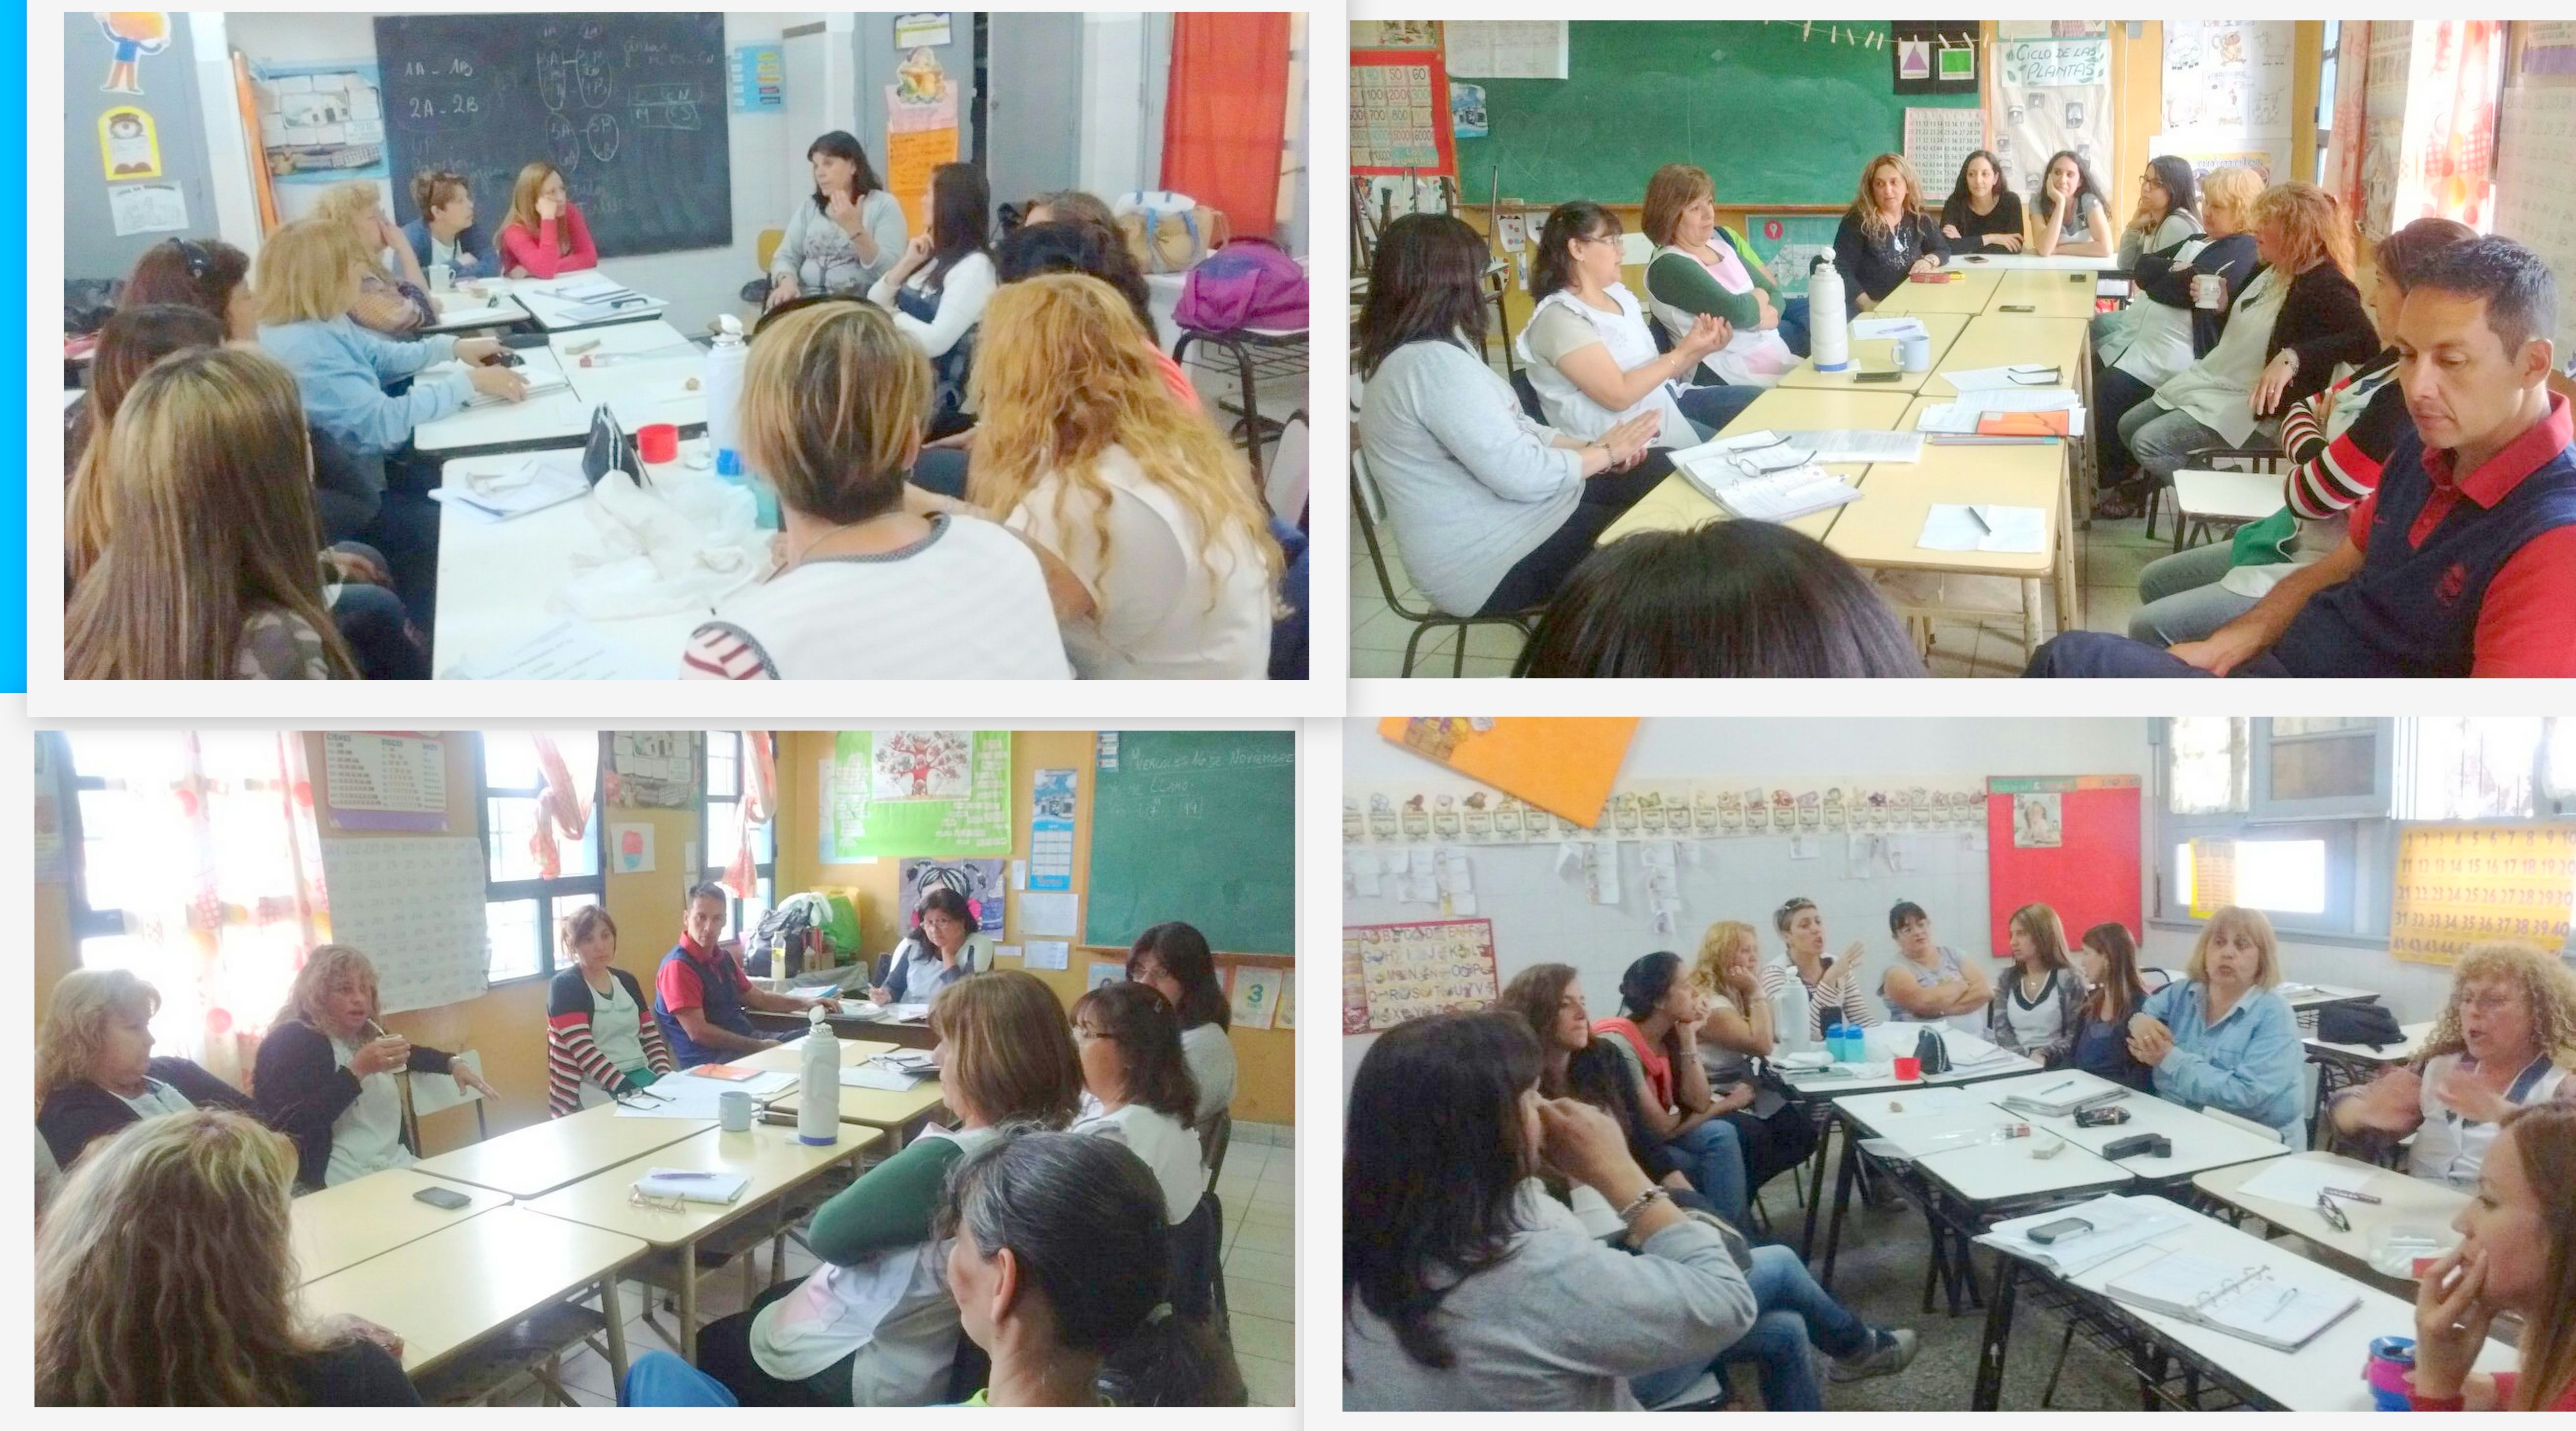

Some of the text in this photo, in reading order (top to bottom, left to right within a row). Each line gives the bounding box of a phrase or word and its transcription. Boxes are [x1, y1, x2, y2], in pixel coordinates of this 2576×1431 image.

[2056, 48, 2070, 58] DE
[2073, 47, 2097, 57] LAS
[1389, 68, 1402, 80] 50
[1412, 68, 1426, 80] 60
[2027, 62, 2095, 80] PLANTAS
[1366, 89, 1429, 100] 100 200 300
[409, 97, 433, 118] 2A
[453, 93, 478, 113] 2B
[1369, 110, 1386, 121] 700
[1392, 110, 1408, 121] 800
[1415, 130, 1431, 141] 6000
[2198, 155, 2264, 168] animales
[2408, 830, 2576, 847] 1 2 3 4 5 6 7 8 9 10
[2402, 858, 2576, 875] 11 12 13 14 15 16 17 18 19 20
[2399, 886, 2573, 906] 21 22 23 24 25 26 27 28 29 30
[2396, 911, 2570, 936] 31 32 33 34 35 36 37 38 39 40
[1361, 931, 1368, 941] A
[1383, 930, 1390, 941] B
[1425, 928, 1432, 939] D
[1449, 927, 1455, 937] E
[1450, 946, 1456, 956] K
[2395, 937, 2405, 950] 41
[2410, 939, 2422, 952] 42
[2426, 939, 2438, 952] 43
[2442, 940, 2453, 954] 44
[1247, 983, 1263, 1002] 3
[1390, 989, 1399, 1000] R
[1412, 988, 1419, 998] S
